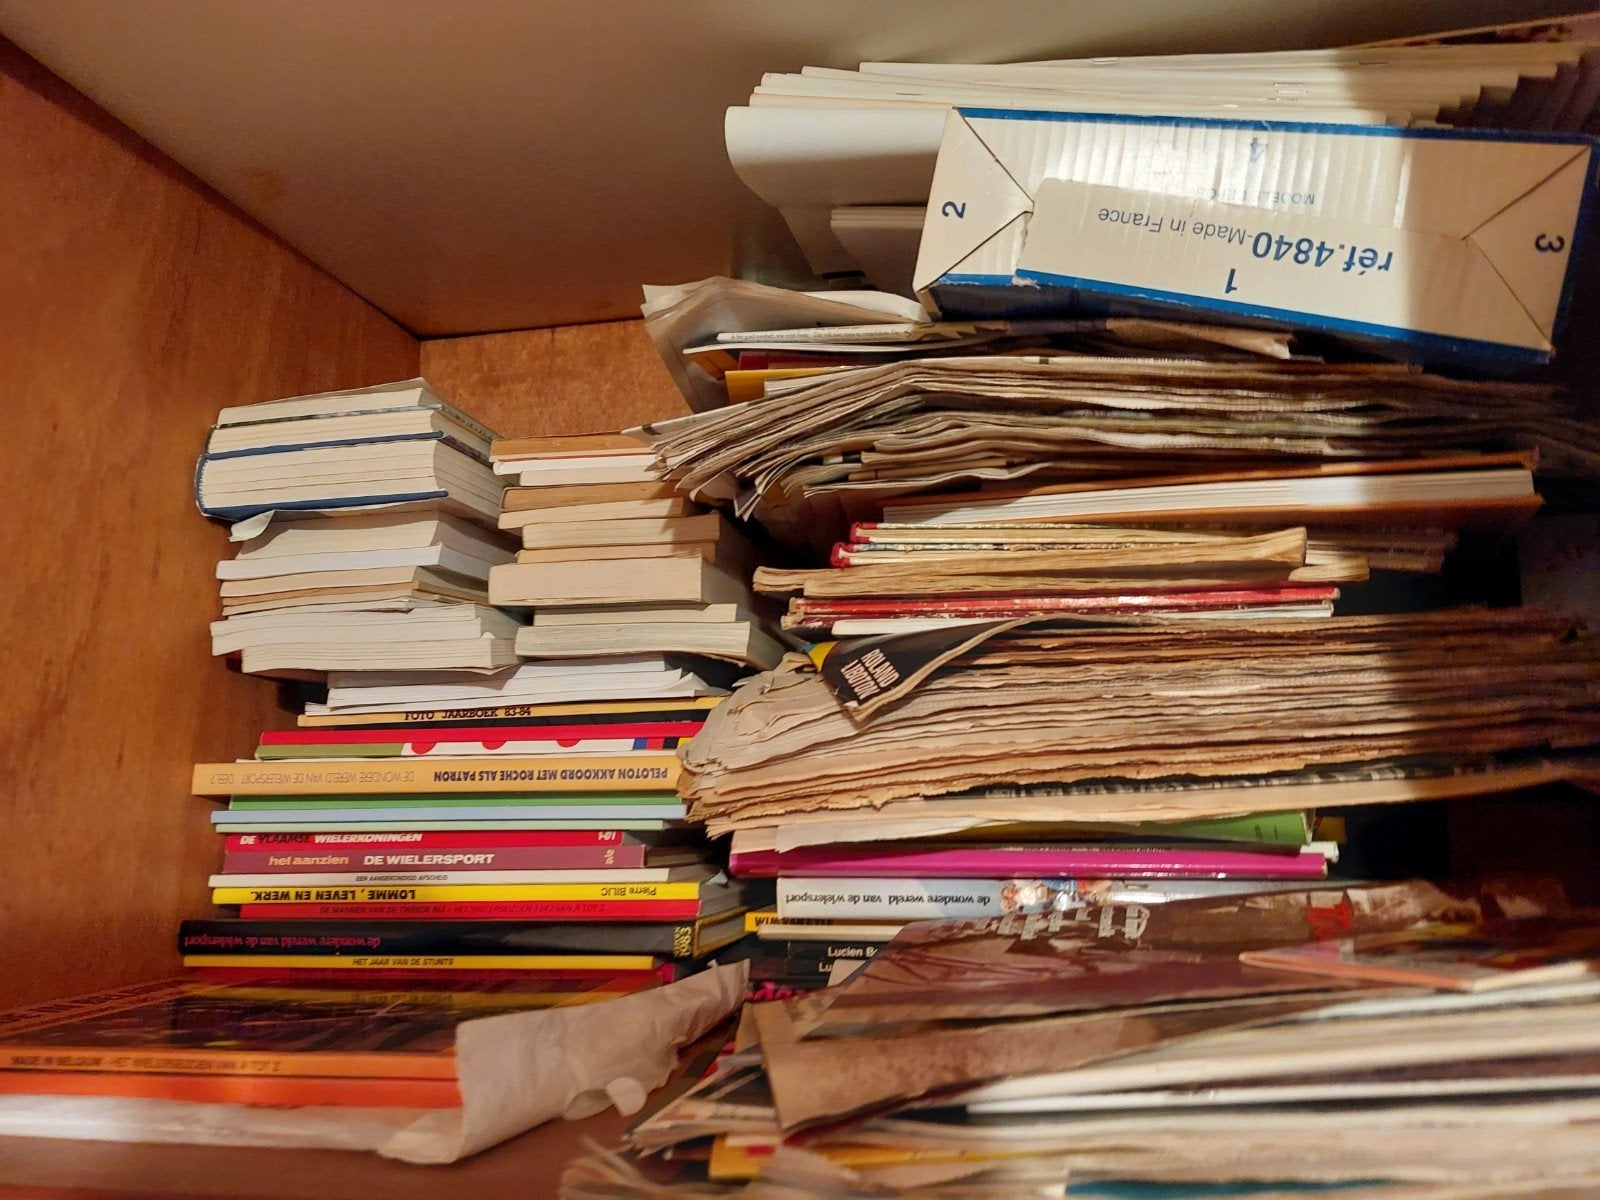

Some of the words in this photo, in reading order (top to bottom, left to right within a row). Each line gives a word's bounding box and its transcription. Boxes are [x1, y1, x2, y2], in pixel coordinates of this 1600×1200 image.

[1250, 137, 1268, 163] 4
[942, 201, 966, 218] 2
[1098, 207, 1164, 233] France
[1170, 218, 1187, 237] in
[1535, 233, 1565, 253] 3
[1224, 268, 1238, 294] 1
[860, 648, 900, 688] ROLAND
[840, 659, 880, 700] LIBOTON
[404, 711, 435, 721] FOTO
[441, 706, 499, 719] JAARBOEK
[504, 705, 532, 717] 83-84
[241, 773, 292, 784] WIELERSPORT
[293, 773, 304, 784] DE
[306, 773, 324, 784] VAN
[324, 772, 358, 783] WERELD
[358, 771, 401, 783] WONDERE
[402, 771, 415, 782] DE
[433, 771, 476, 782] PATRON
[478, 770, 497, 782] ALS
[499, 770, 534, 781] ROCHE
[537, 769, 557, 781] MET
[560, 768, 614, 780] AKKOORD
[618, 767, 669, 779] PELOTON
[240, 835, 256, 845] DE
[314, 833, 422, 844] WIELERKONINGEN
[268, 856, 291, 867] het
[292, 855, 349, 866] aanzien
[363, 855, 384, 866] DE
[386, 853, 495, 866] WIELERSPORT
[251, 890, 291, 901] WERK.
[294, 890, 311, 901] EN
[315, 890, 356, 901] LEVEN
[600, 887, 626, 897] BILIC
[628, 887, 657, 896] Pierre
[785, 892, 845, 905] wielersport
[847, 894, 861, 904] de
[862, 895, 882, 903] van
[888, 895, 924, 905] wereld
[927, 895, 974, 905] wondere
[977, 895, 990, 906] de
[399, 905, 431, 913] TWEEDE
[453, 905, 468, 913] HET
[581, 904, 597, 912] TOT
[184, 934, 243, 947] wielersport
[246, 937, 259, 947] de
[260, 937, 279, 946] van
[281, 937, 318, 947] wereld
[319, 937, 366, 947] wondere
[367, 937, 381, 948] de
[828, 946, 863, 958] Lucien
[352, 958, 368, 966] HET
[369, 958, 390, 966] JAAR
[392, 958, 408, 966] VAN
[410, 958, 421, 966] DE
[423, 957, 454, 966] STUNTS
